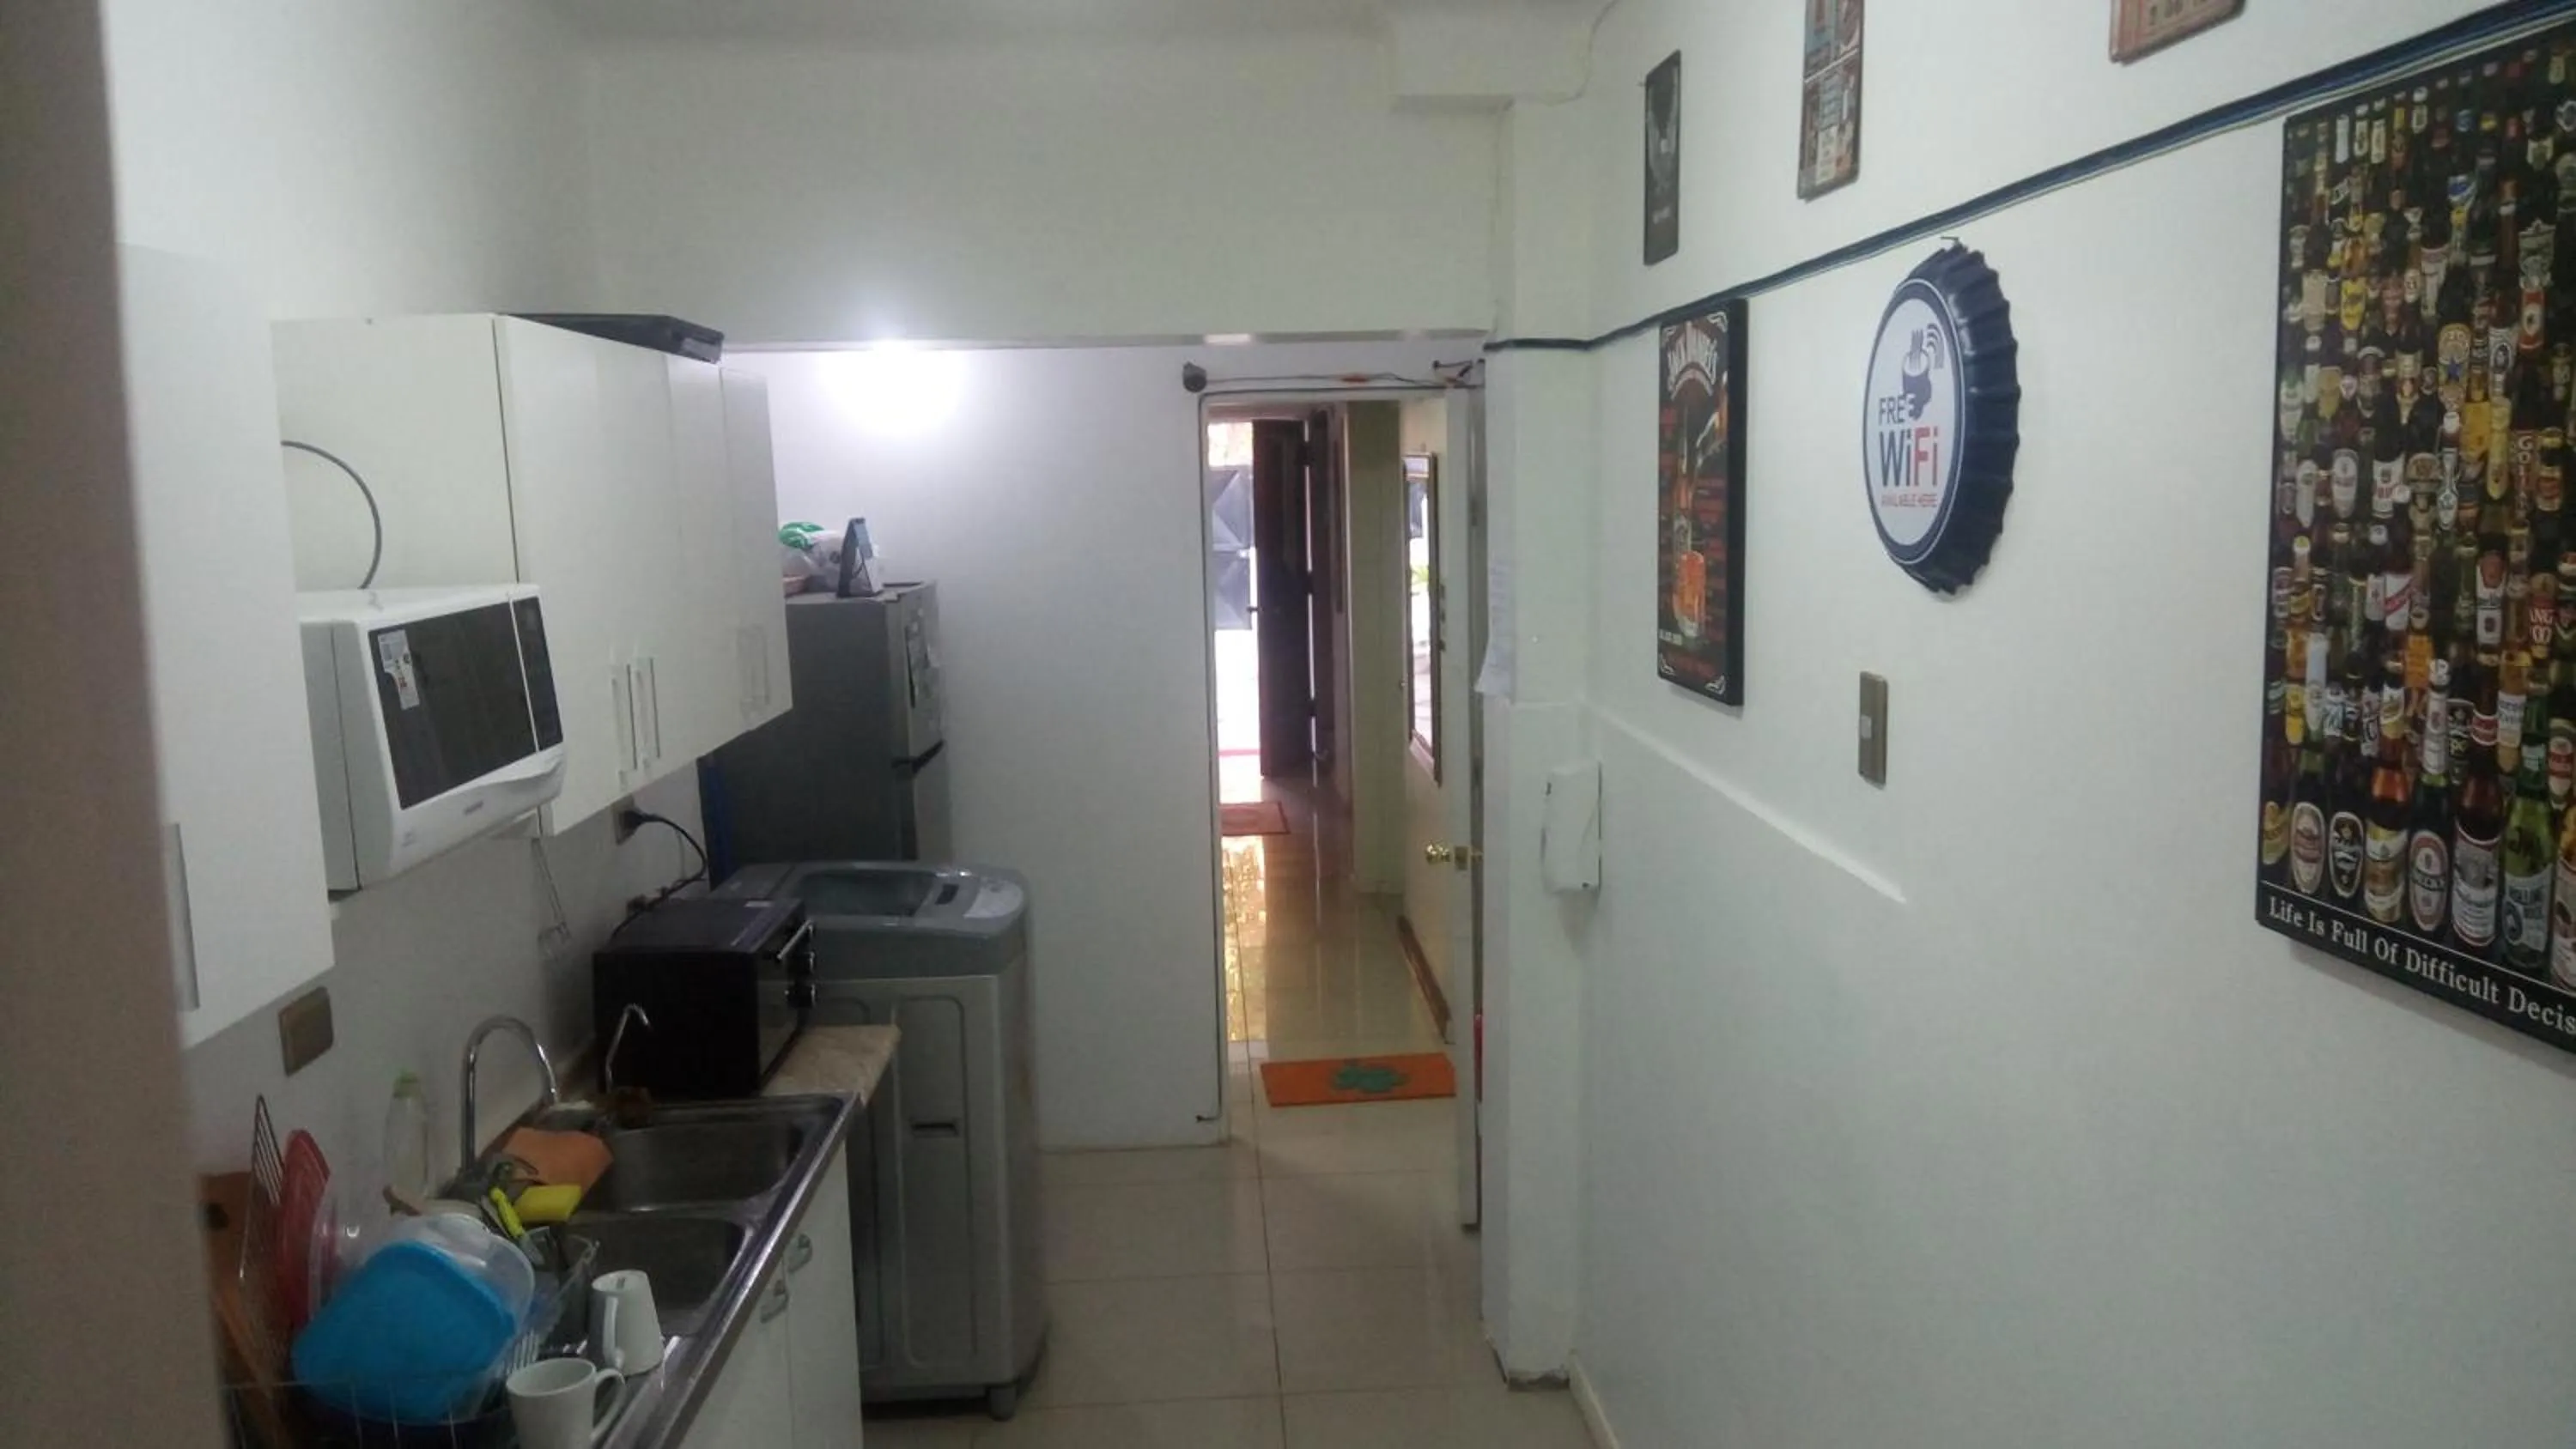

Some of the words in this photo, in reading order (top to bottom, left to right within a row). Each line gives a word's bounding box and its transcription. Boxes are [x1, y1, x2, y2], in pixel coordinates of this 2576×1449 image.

[1878, 394, 1916, 426] FREE
[1878, 426, 1938, 488] WiFi
[2269, 896, 2303, 925] Life
[2307, 910, 2325, 936] Is
[2331, 921, 2368, 954] Full
[2373, 937, 2399, 965] Of
[2404, 948, 2500, 1004] Difficult
